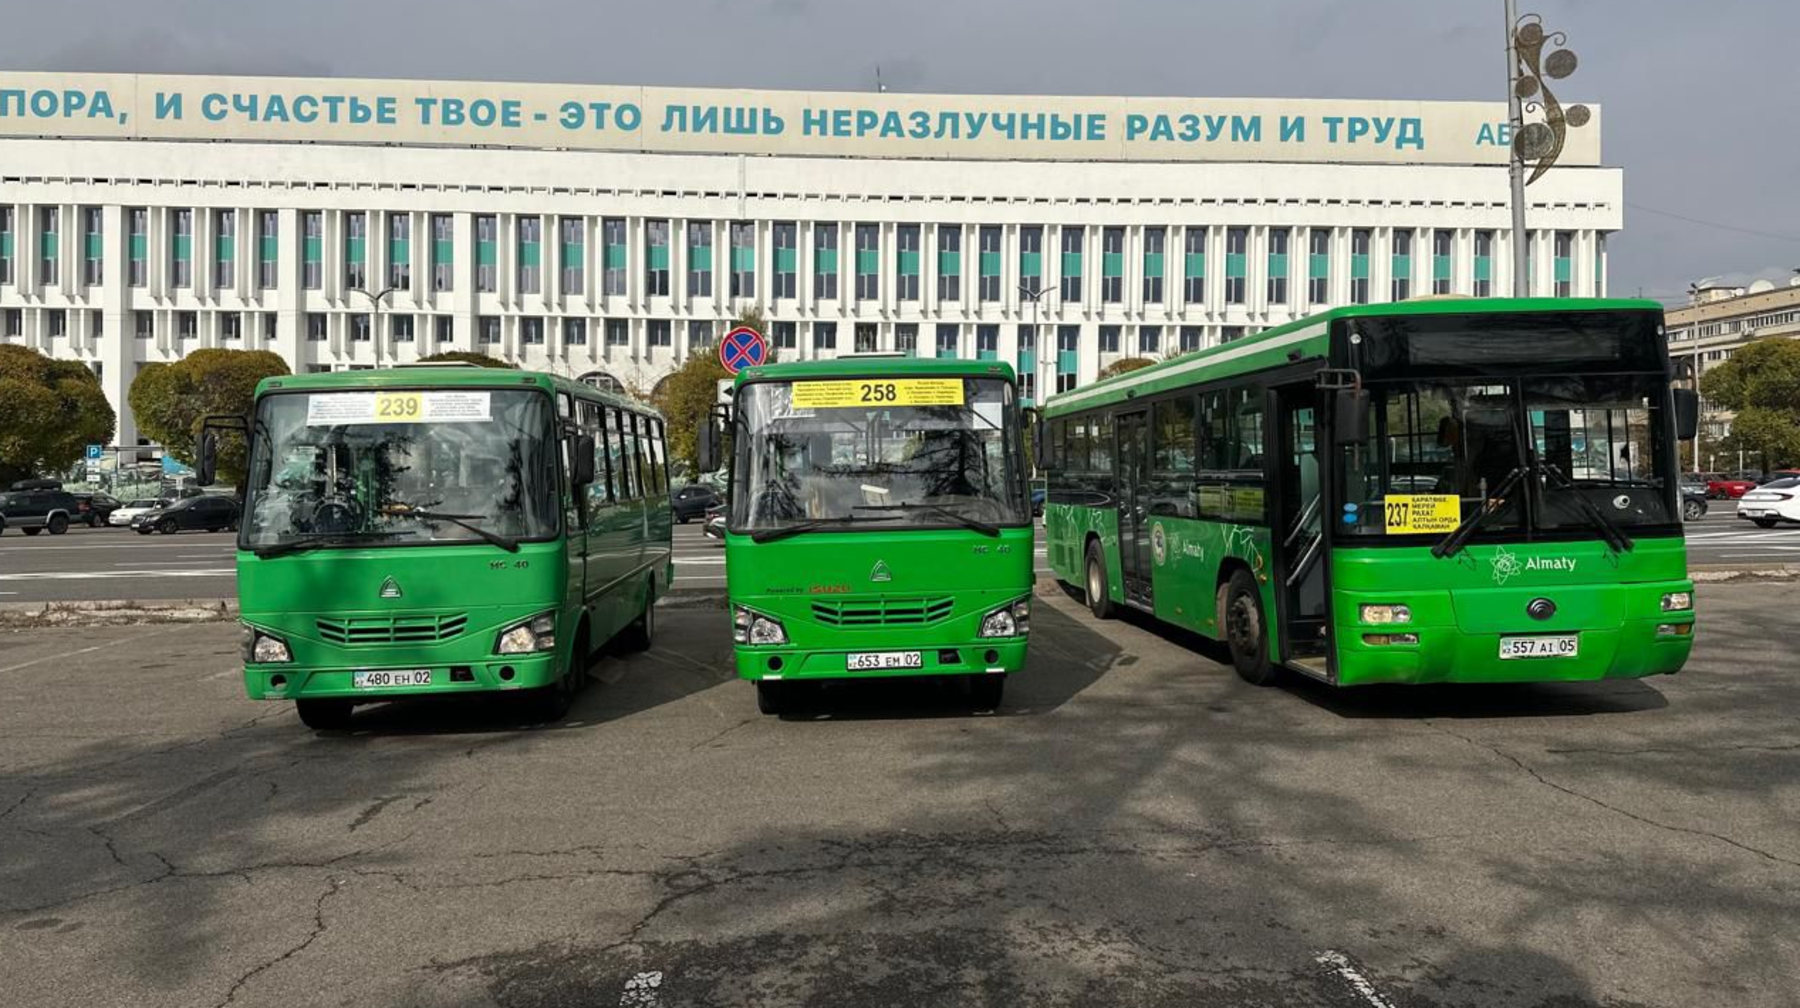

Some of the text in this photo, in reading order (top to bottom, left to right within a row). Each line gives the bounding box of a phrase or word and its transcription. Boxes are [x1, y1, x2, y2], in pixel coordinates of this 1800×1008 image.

[0, 89, 1426, 149] ПОРА, И СЧАСТЬЕ ТВОЕ - ЭТО ЛИШЬ НЕРАЗЛУЧНЫЕ РАЗУМ И ТРУД
[861, 384, 897, 402] 258
[379, 398, 418, 417] 239
[1387, 502, 1409, 527] 237
[996, 544, 1012, 554] 40
[513, 560, 529, 570] 40
[1525, 556, 1577, 572] Almaty
[1513, 641, 1536, 653] 557
[1540, 643, 1553, 653] AI
[1559, 640, 1575, 652] 05
[857, 655, 880, 667] 653
[886, 657, 900, 667] EM
[905, 653, 920, 665] 02
[367, 672, 390, 685] 480
[394, 674, 410, 685] EH
[415, 671, 430, 684] 02
